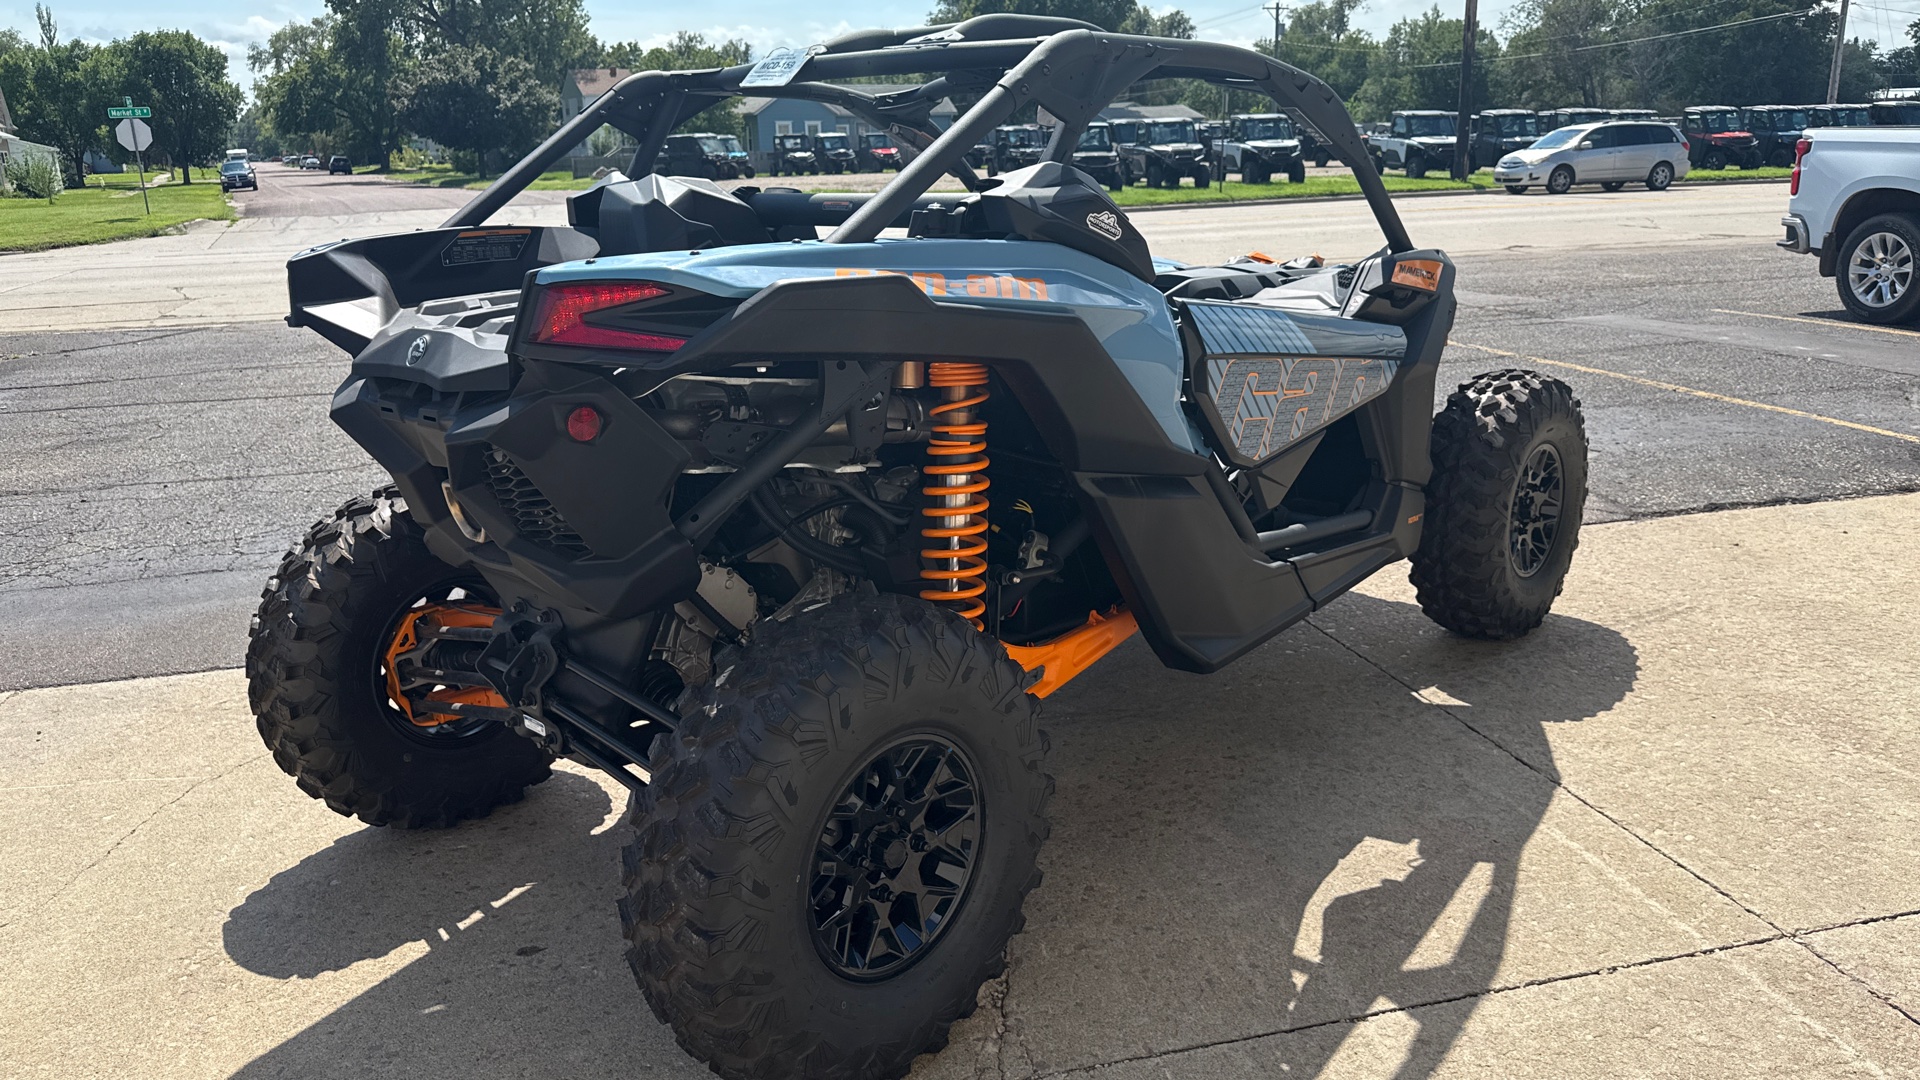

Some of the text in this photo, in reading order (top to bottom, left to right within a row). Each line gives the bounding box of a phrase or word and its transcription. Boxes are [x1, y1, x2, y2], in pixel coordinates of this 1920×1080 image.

[111, 109, 133, 117] Market
[1088, 216, 1120, 236] MOTORSPORTS
[835, 268, 1049, 300] n-am
